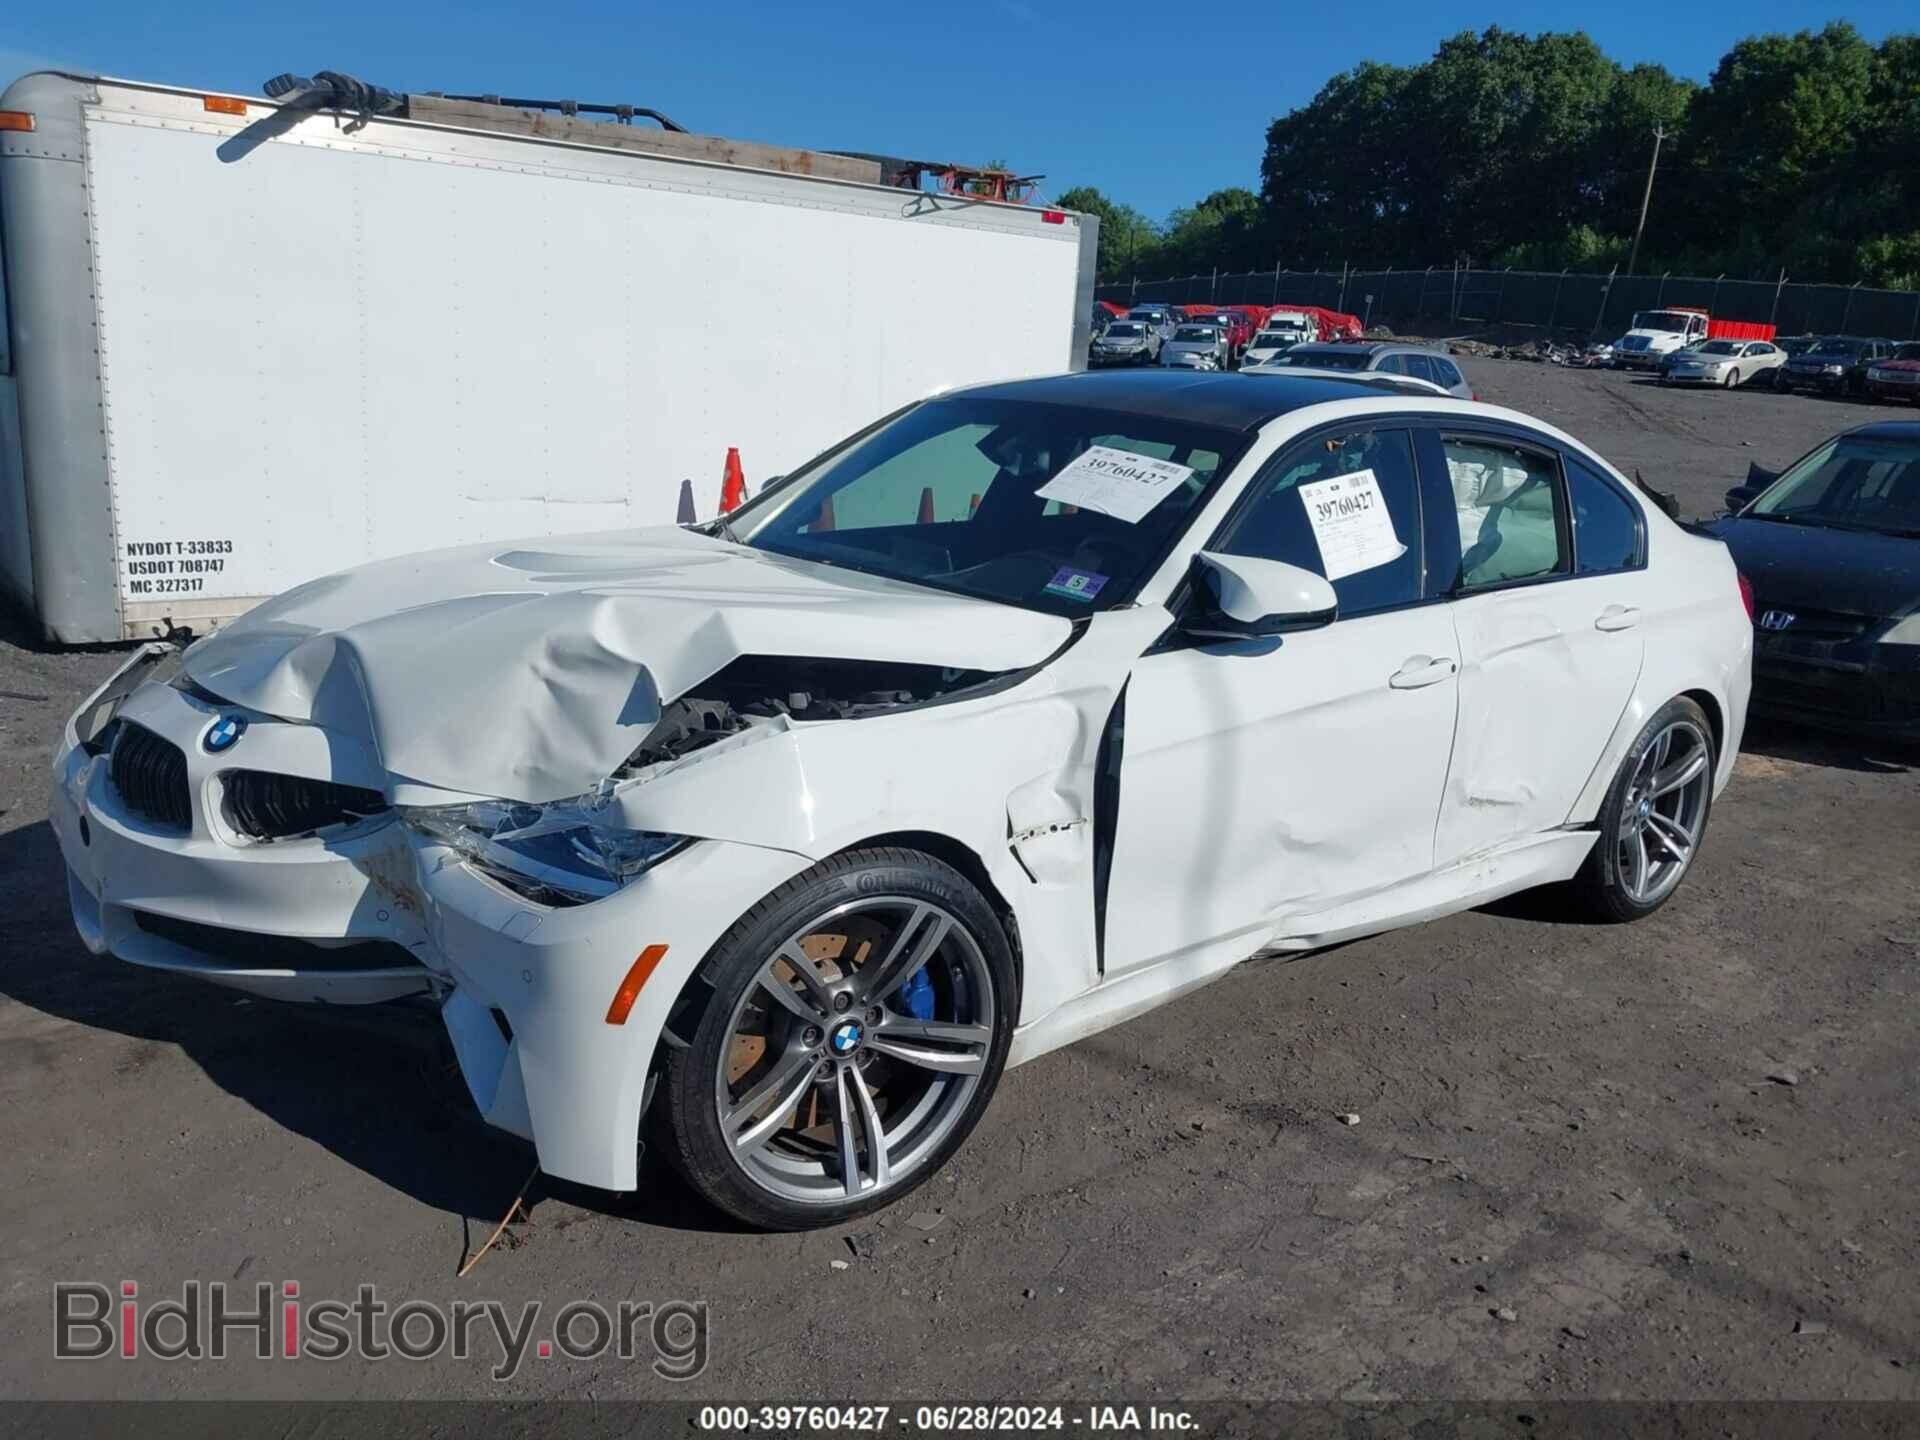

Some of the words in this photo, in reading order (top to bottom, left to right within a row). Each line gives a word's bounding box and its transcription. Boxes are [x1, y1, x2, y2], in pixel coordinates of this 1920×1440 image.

[1082, 459, 1168, 486] 39760427
[1315, 490, 1374, 522] 39760427
[127, 542, 172, 556] NYDOT
[176, 540, 232, 554] T-33833
[129, 561, 174, 575] USDOT
[178, 559, 224, 573] 708747
[130, 580, 152, 593] MC
[156, 578, 203, 592] 327317
